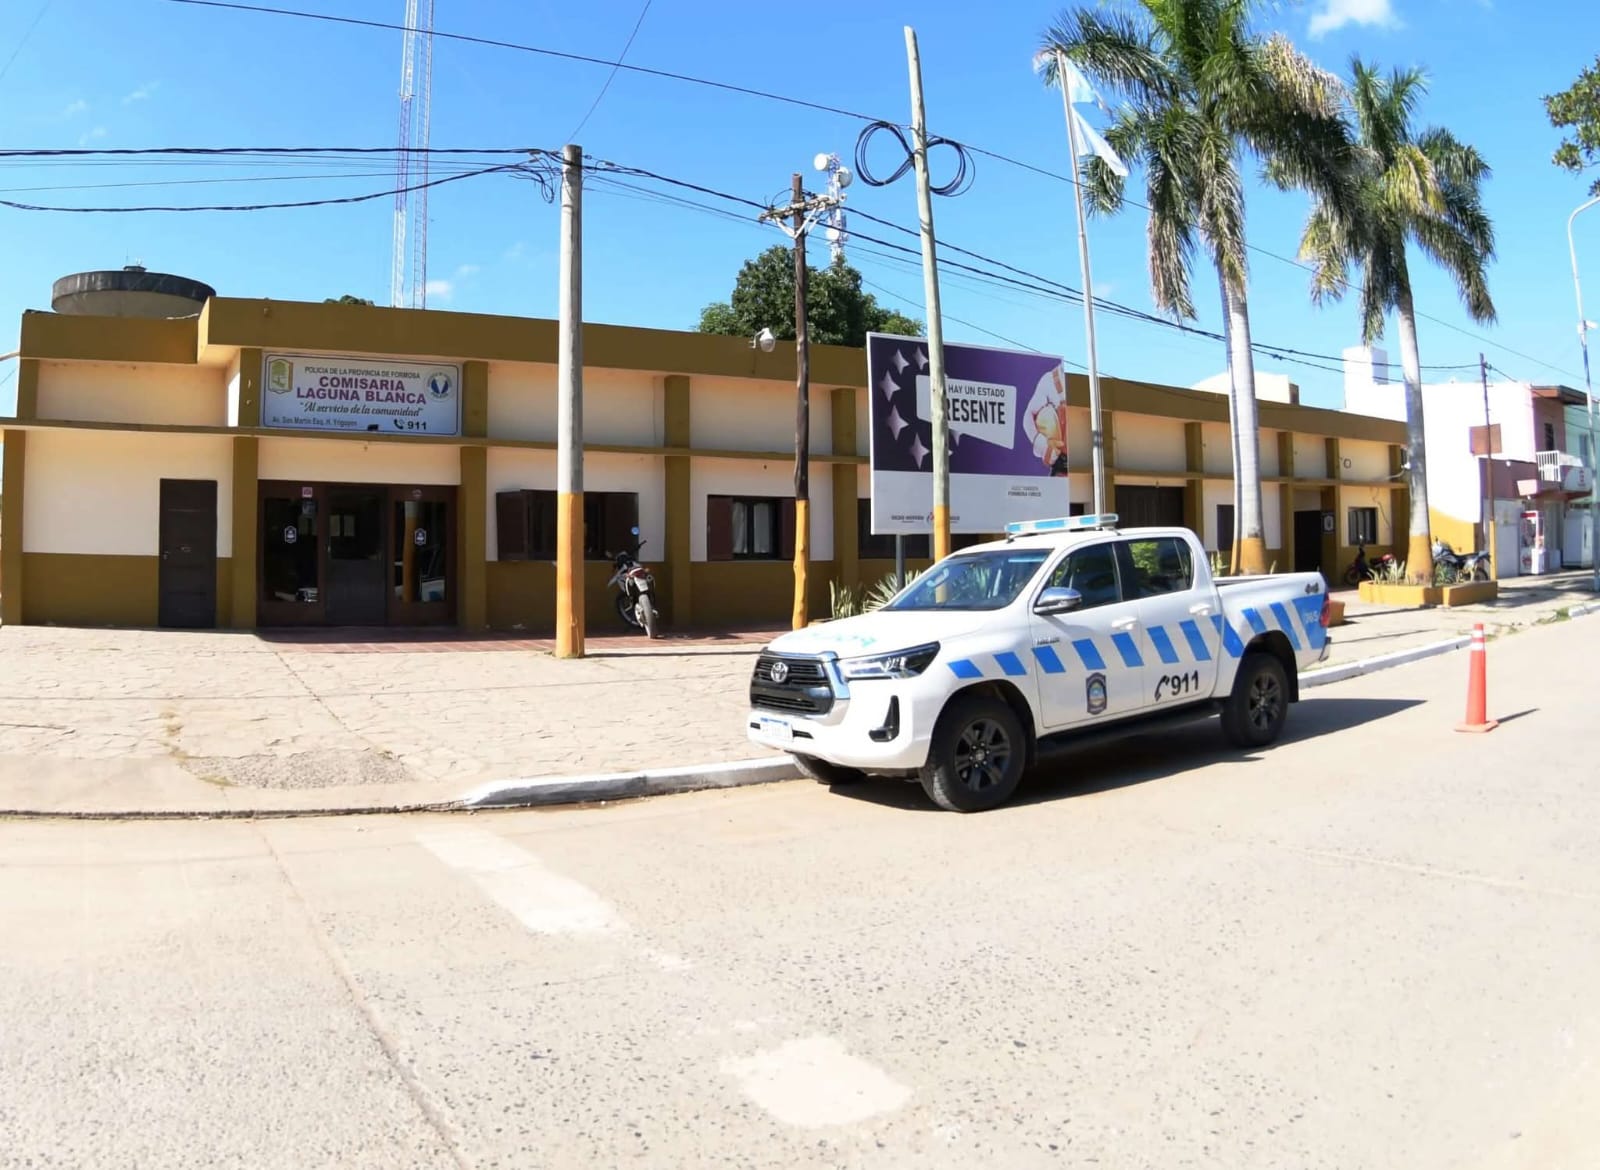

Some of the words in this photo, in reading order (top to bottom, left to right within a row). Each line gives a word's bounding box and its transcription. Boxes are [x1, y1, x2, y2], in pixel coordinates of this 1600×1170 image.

[319, 376, 405, 391] COMISARIA
[297, 387, 360, 401] LAGUNA
[365, 391, 426, 405] BLANCA
[948, 384, 963, 393] HAY
[965, 385, 976, 395] UN
[977, 387, 1005, 398] ESTADO
[316, 404, 349, 413] servicio
[350, 404, 361, 414] de
[361, 404, 370, 415] la
[407, 421, 427, 430] 911
[1171, 669, 1199, 696] 911
